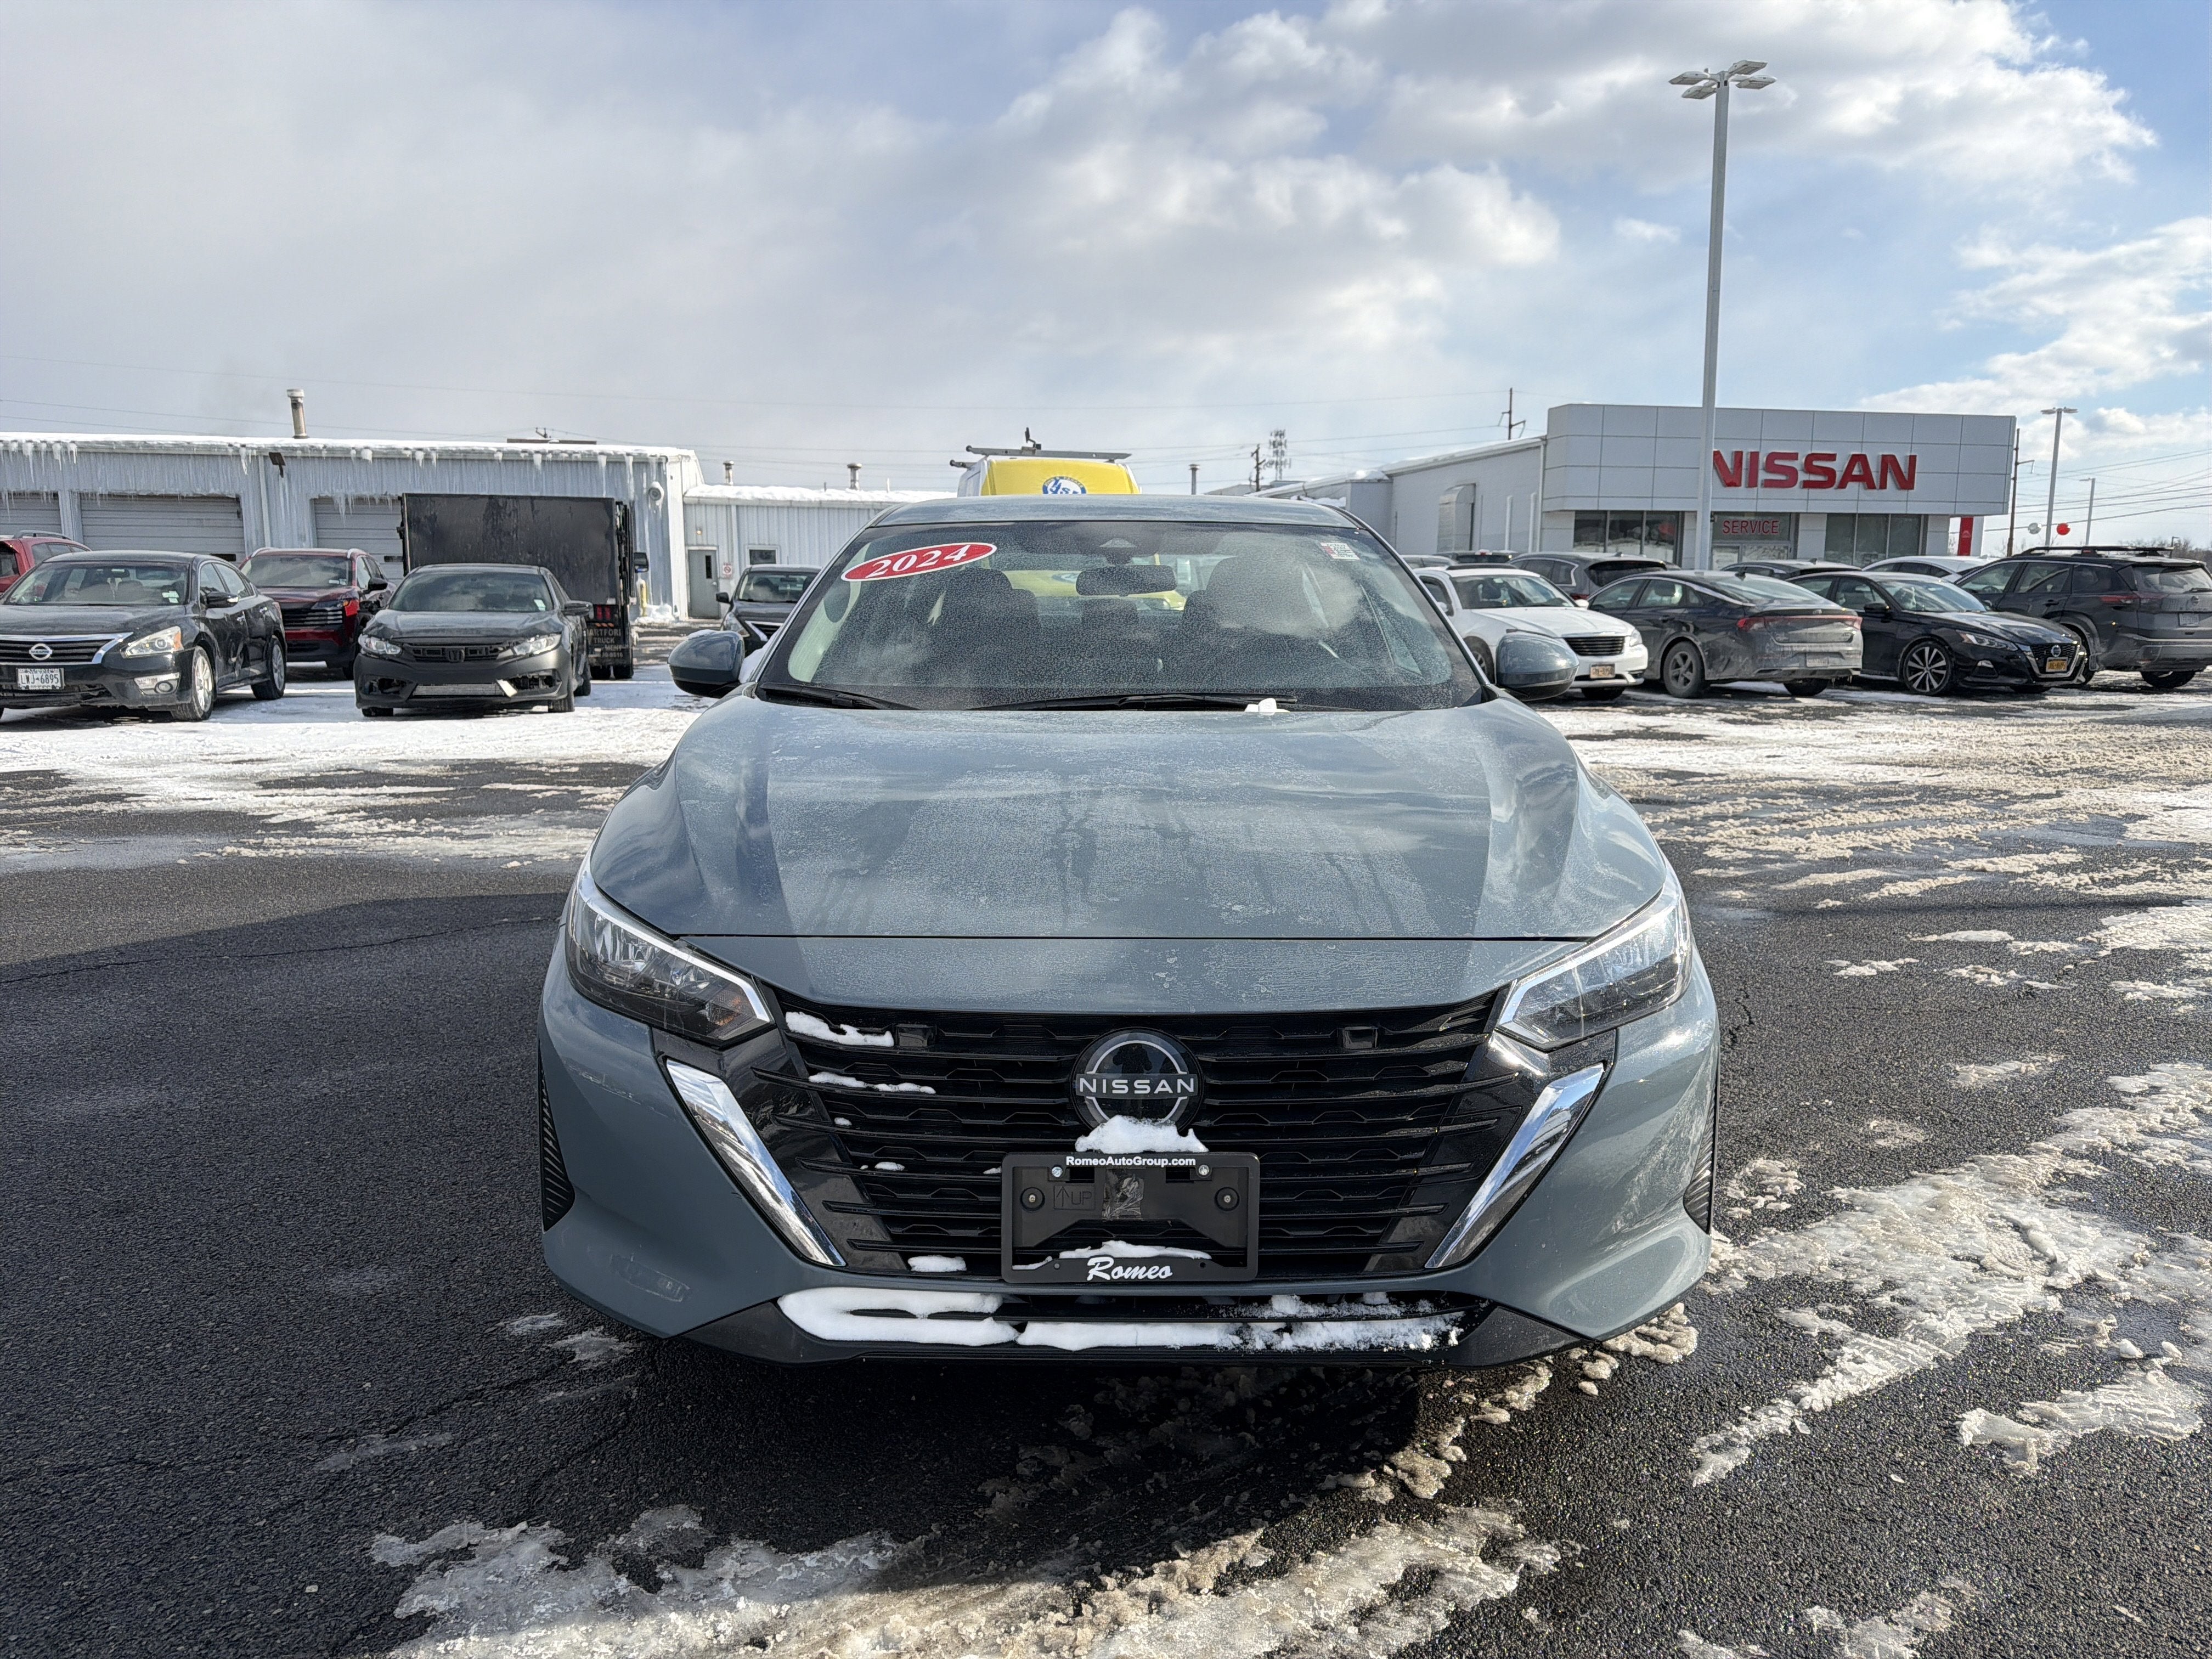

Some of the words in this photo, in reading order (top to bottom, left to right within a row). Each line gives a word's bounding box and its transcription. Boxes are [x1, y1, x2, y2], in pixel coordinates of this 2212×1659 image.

[1713, 449, 1917, 490] NISSAN
[1722, 520, 1779, 535] SERVICE
[865, 544, 970, 578] 2024
[40, 674, 59, 684] 6895
[1079, 1077, 1194, 1094] NISSAN
[1066, 1156, 1196, 1167] RomeoAutoGroup.com
[1071, 1191, 1092, 1205] UP
[1087, 1256, 1173, 1281] Romeo
